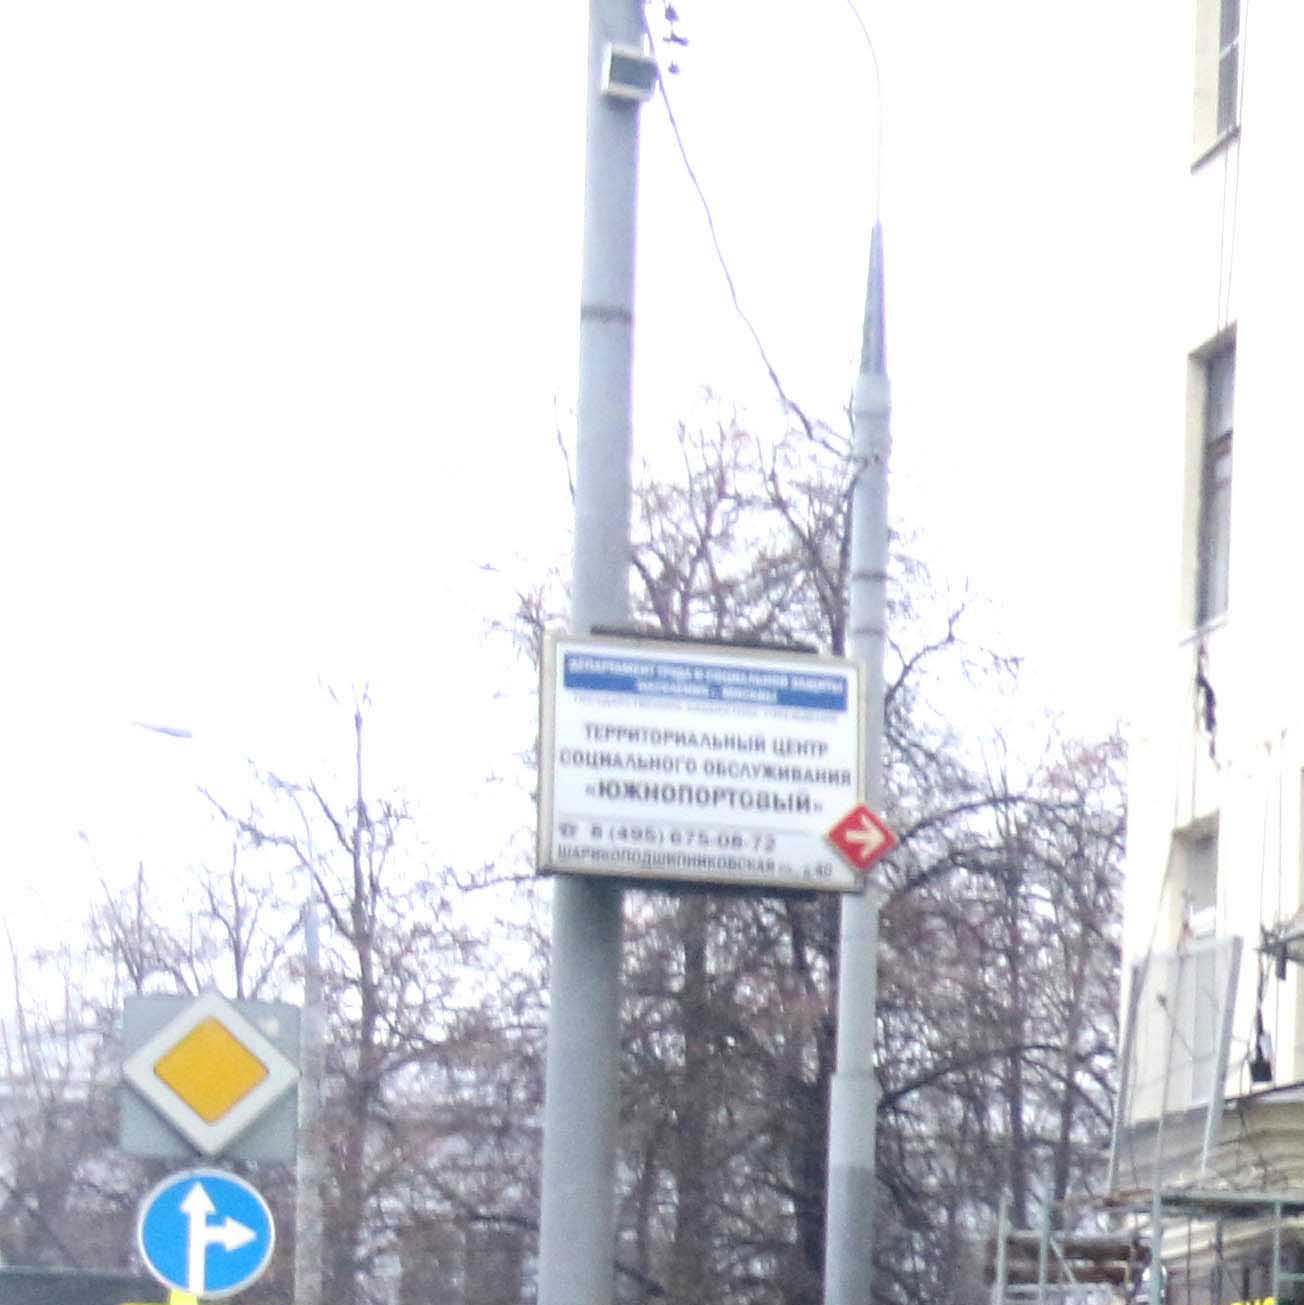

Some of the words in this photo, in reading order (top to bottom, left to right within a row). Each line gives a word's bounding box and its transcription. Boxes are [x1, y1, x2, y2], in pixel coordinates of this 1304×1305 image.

[585, 722, 765, 753] ТЕРРИТОРИАЛЬНЫЙ
[772, 737, 829, 758] ЦЕНТР
[559, 749, 698, 774] СОЦИАЛЬНОГО
[703, 760, 851, 786] ОБСЛУЖИВАНИЯ
